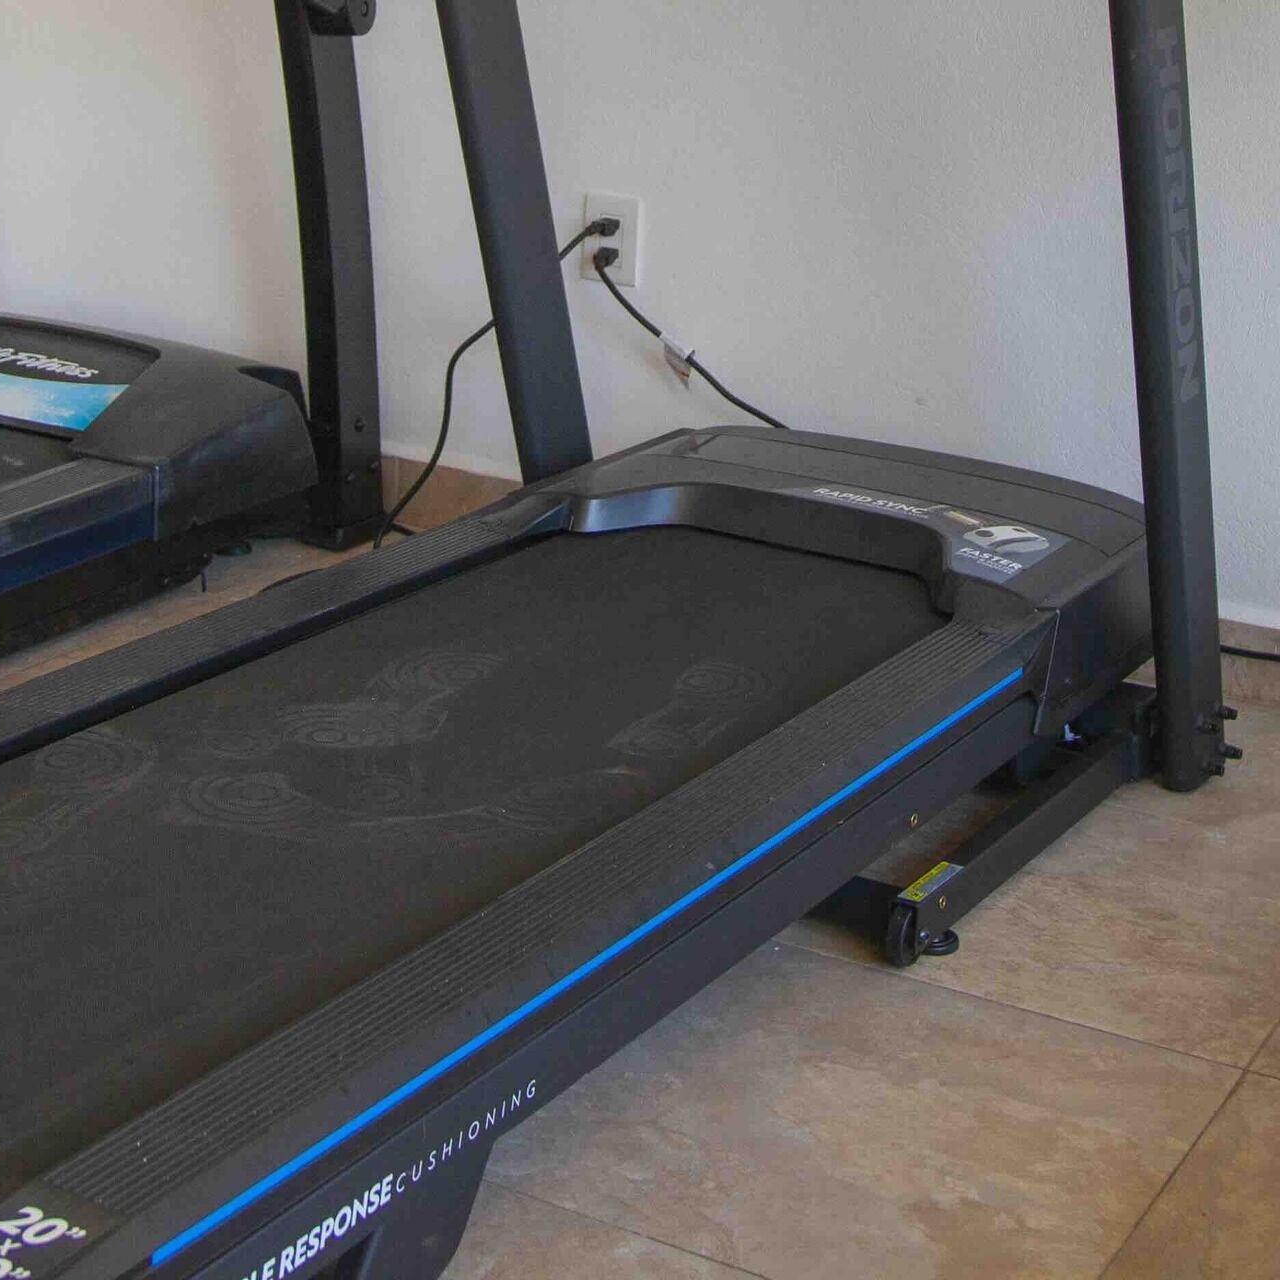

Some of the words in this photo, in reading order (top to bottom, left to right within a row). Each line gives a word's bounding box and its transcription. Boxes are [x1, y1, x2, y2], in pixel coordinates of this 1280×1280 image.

[812, 487, 873, 503] RAPID
[872, 499, 929, 514] SYNC
[957, 547, 1023, 571] FASTER
[278, 1173, 394, 1280] RESPONSE
[395, 1079, 537, 1193] CUSHIONING
